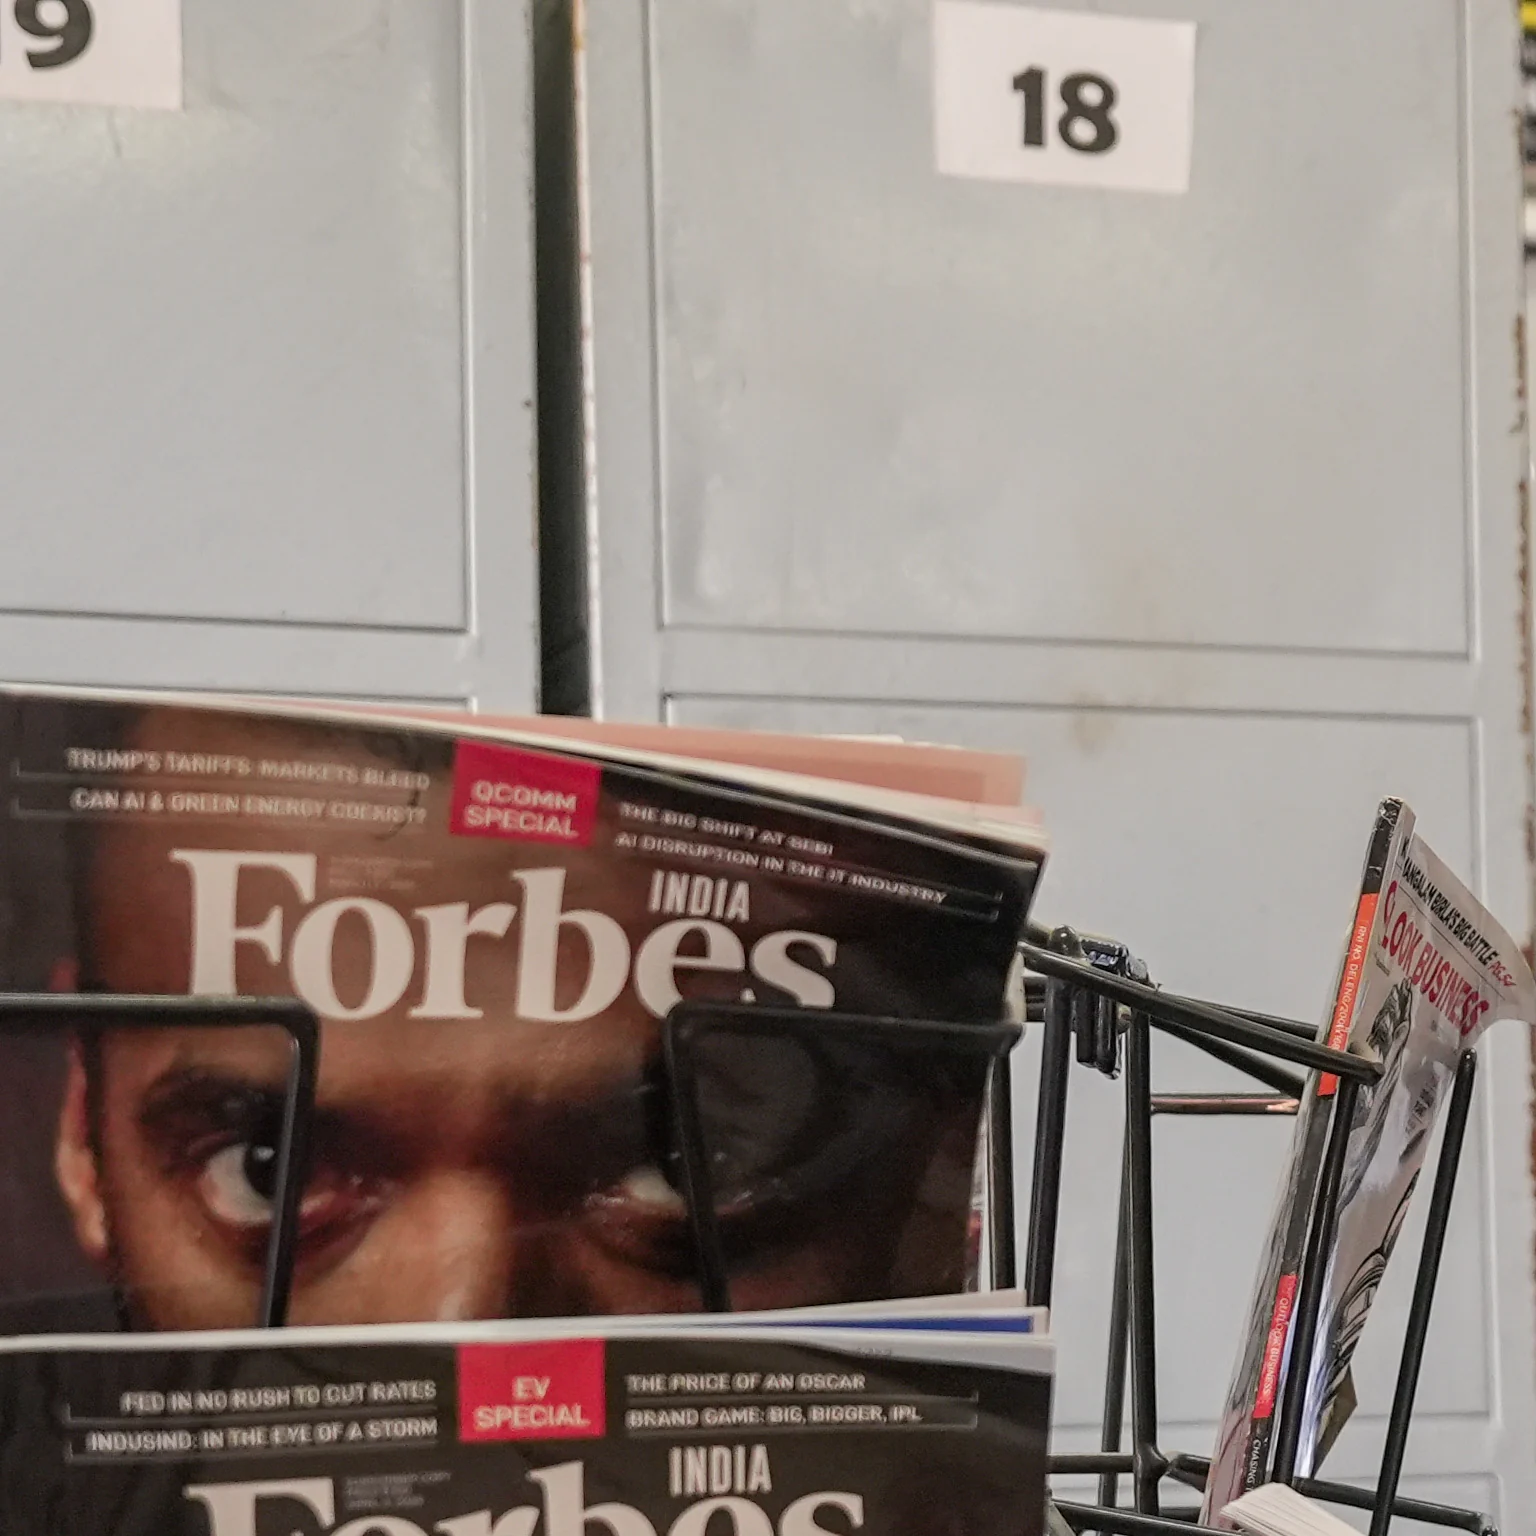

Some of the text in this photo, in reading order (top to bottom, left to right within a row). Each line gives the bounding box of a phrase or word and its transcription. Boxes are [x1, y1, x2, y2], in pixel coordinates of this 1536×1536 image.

[1007, 65, 1121, 155] 18
[472, 779, 577, 813] QCOMM
[465, 806, 580, 840] SPECIAL
[619, 802, 658, 822] THE
[663, 809, 699, 830] BIG
[640, 835, 760, 870] DISRUPTION
[851, 871, 949, 905] INDUSTRY
[649, 869, 751, 920] INDIA
[169, 847, 838, 1023] Forbes
[1411, 938, 1490, 1037] BUSINESS
[1261, 1297, 1290, 1396] OUTLOOK BUSINESS
[292, 1384, 321, 1408] TO
[513, 1374, 549, 1402] EV
[797, 1373, 867, 1393] OSCAR
[312, 1421, 345, 1444] OF
[364, 1416, 438, 1440] STORM
[474, 1402, 591, 1432] SPECIAL
[668, 1442, 773, 1499] INDIA
[1245, 1438, 1262, 1483] CHASING
